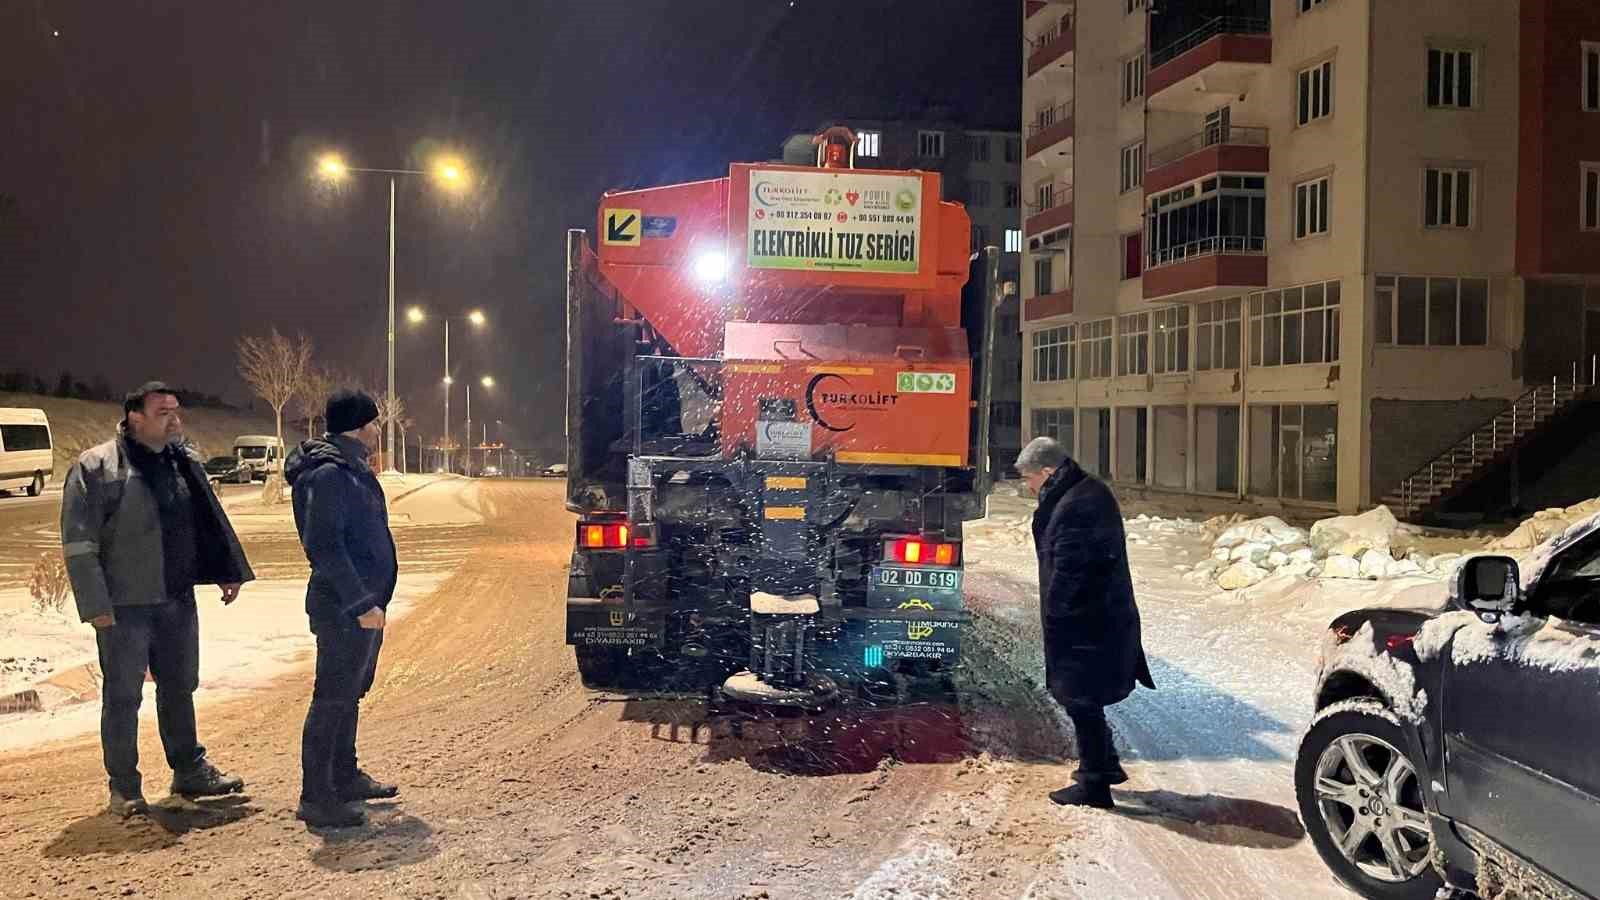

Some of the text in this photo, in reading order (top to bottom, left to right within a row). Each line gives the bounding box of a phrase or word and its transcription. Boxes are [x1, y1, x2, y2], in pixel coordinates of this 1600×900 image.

[753, 227, 915, 262] ELEKTRİKLİ TUZ SERİCİ
[881, 570, 955, 587] 02 DD 619
